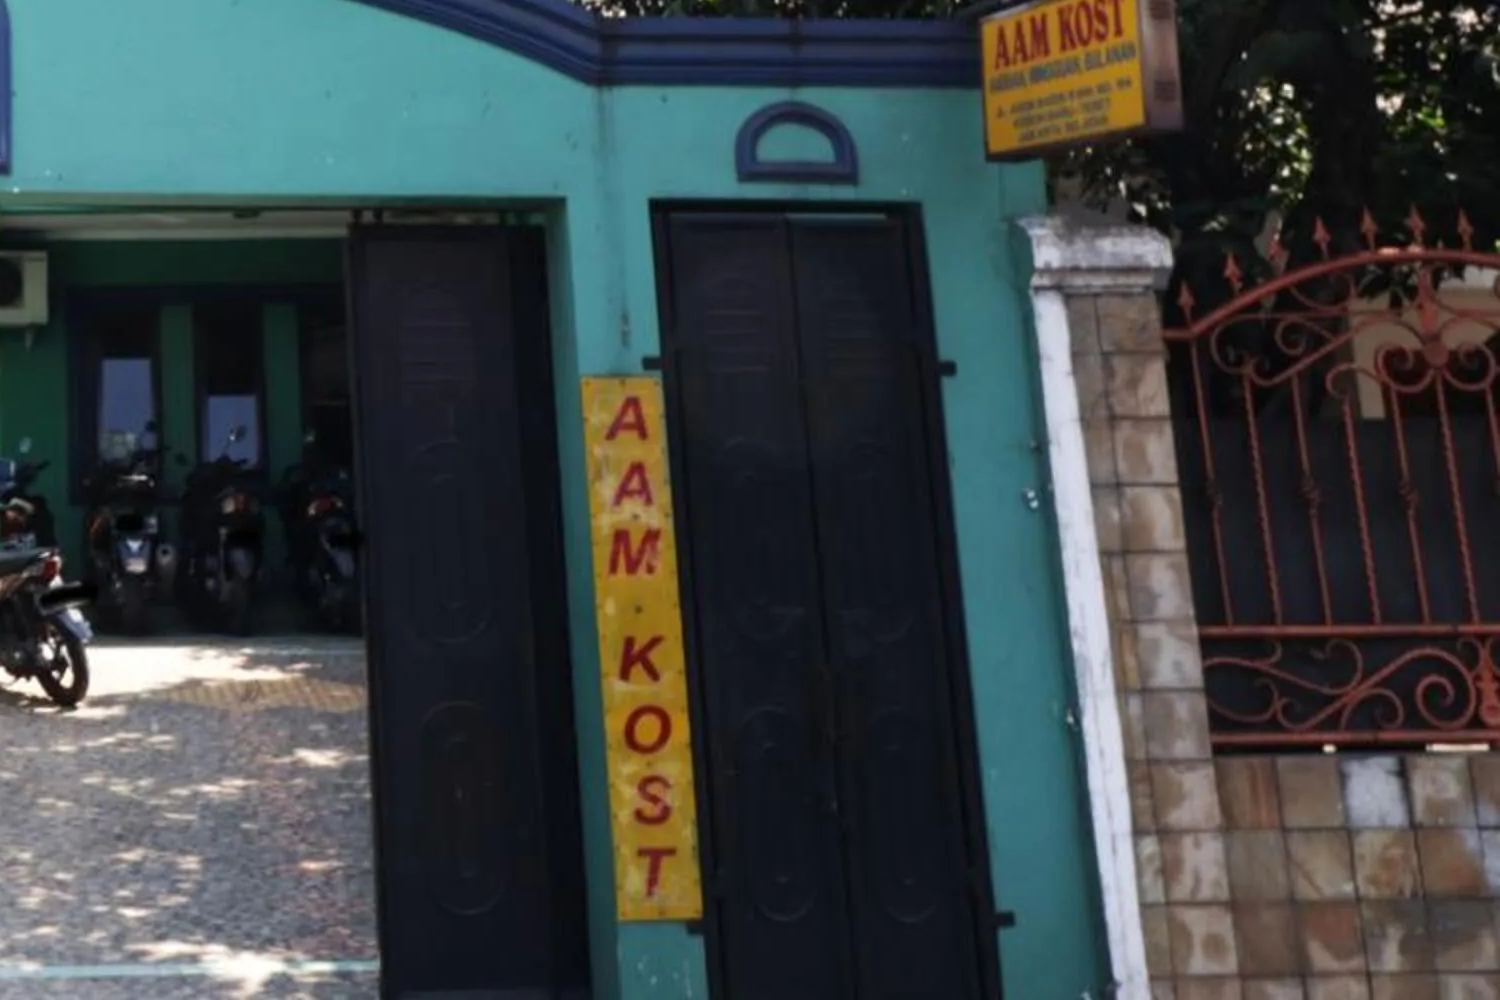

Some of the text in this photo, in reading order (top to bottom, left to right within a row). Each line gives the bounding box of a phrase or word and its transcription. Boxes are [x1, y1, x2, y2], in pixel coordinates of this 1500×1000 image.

[994, 12, 1050, 70] AAM
[604, 394, 678, 898] AAM KOST
